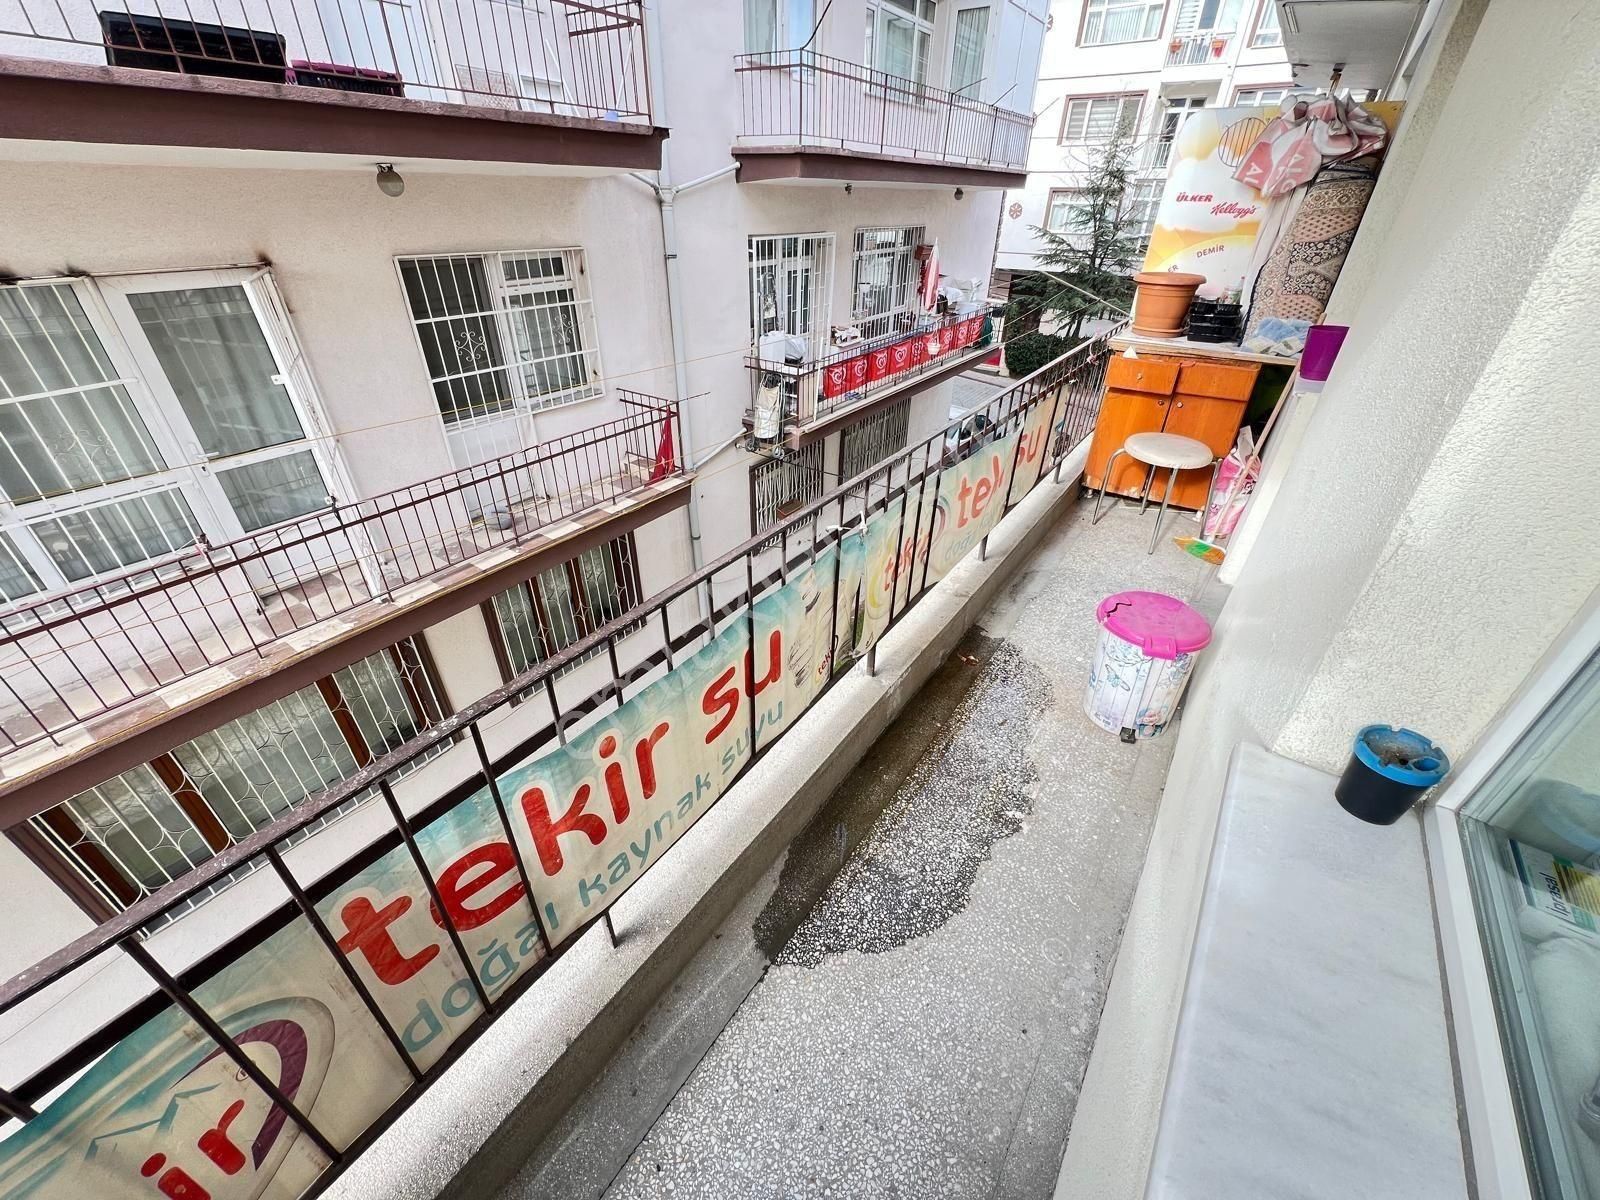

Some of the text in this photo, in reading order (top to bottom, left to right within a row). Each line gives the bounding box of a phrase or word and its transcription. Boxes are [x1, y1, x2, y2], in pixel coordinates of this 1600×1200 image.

[1176, 191, 1214, 203] ÜLKER
[1210, 202, 1257, 219] Kellogg's
[1196, 244, 1226, 259] DEMİR
[336, 629, 782, 986] tekir su
[398, 700, 784, 1054] doğal kaynak suyu
